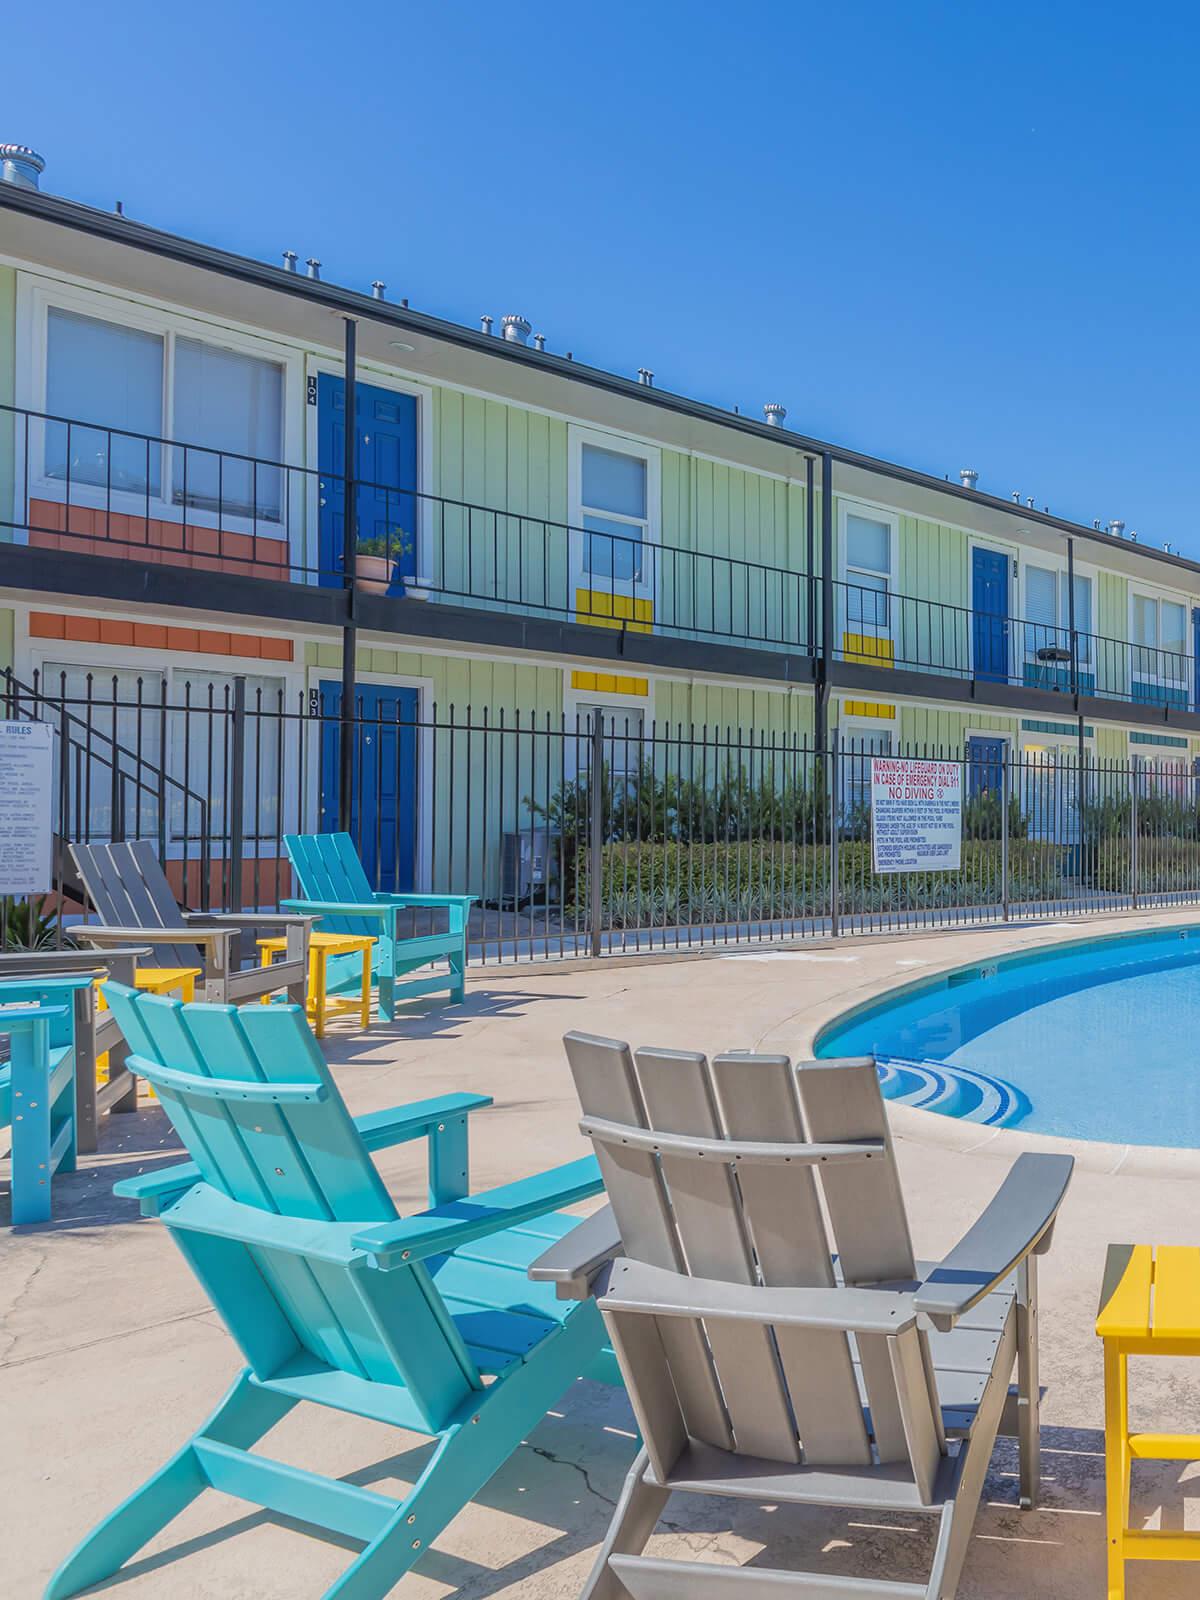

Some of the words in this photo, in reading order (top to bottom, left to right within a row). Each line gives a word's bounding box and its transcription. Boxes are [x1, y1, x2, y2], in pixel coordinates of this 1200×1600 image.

[308, 378, 316, 404] 104
[310, 690, 318, 716] 103
[7, 725, 32, 735] RULES
[910, 760, 937, 774] LIFEGUARD
[938, 763, 945, 775] ON
[946, 763, 960, 776] DUTY
[874, 773, 880, 785] IN
[881, 773, 896, 785] CASE
[897, 774, 905, 786] OF
[906, 774, 937, 787] EMERGENCY
[938, 776, 949, 787] DIAL
[951, 776, 960, 788] 911
[889, 787, 902, 799] NO
[905, 787, 935, 799] DIVING
